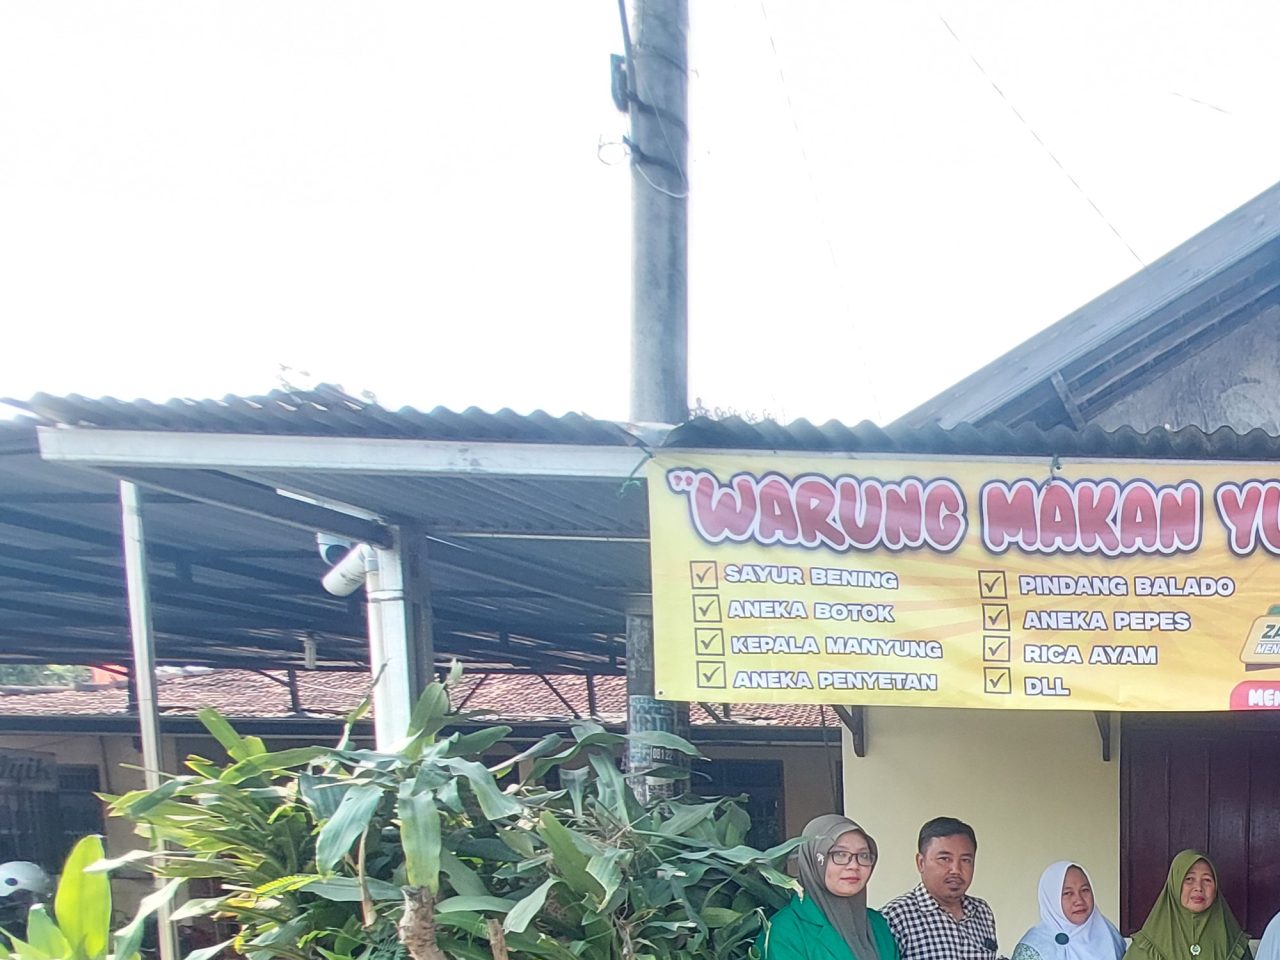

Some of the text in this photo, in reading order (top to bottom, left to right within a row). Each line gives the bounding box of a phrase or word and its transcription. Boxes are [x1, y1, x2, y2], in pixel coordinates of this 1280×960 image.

[979, 476, 1204, 557] MAKAN
[724, 564, 900, 591] SAYUR BENING
[1018, 574, 1236, 598] PINDANG BALADO
[727, 600, 896, 623] ANEKA BOTOK
[1023, 610, 1192, 632] ANEKA PEPES
[730, 635, 943, 659] KEPALA MANYUNG
[1023, 643, 1159, 666] RICA AYAM
[733, 670, 938, 692] ANEKA PENYETAN
[1023, 676, 1070, 697] DLL
